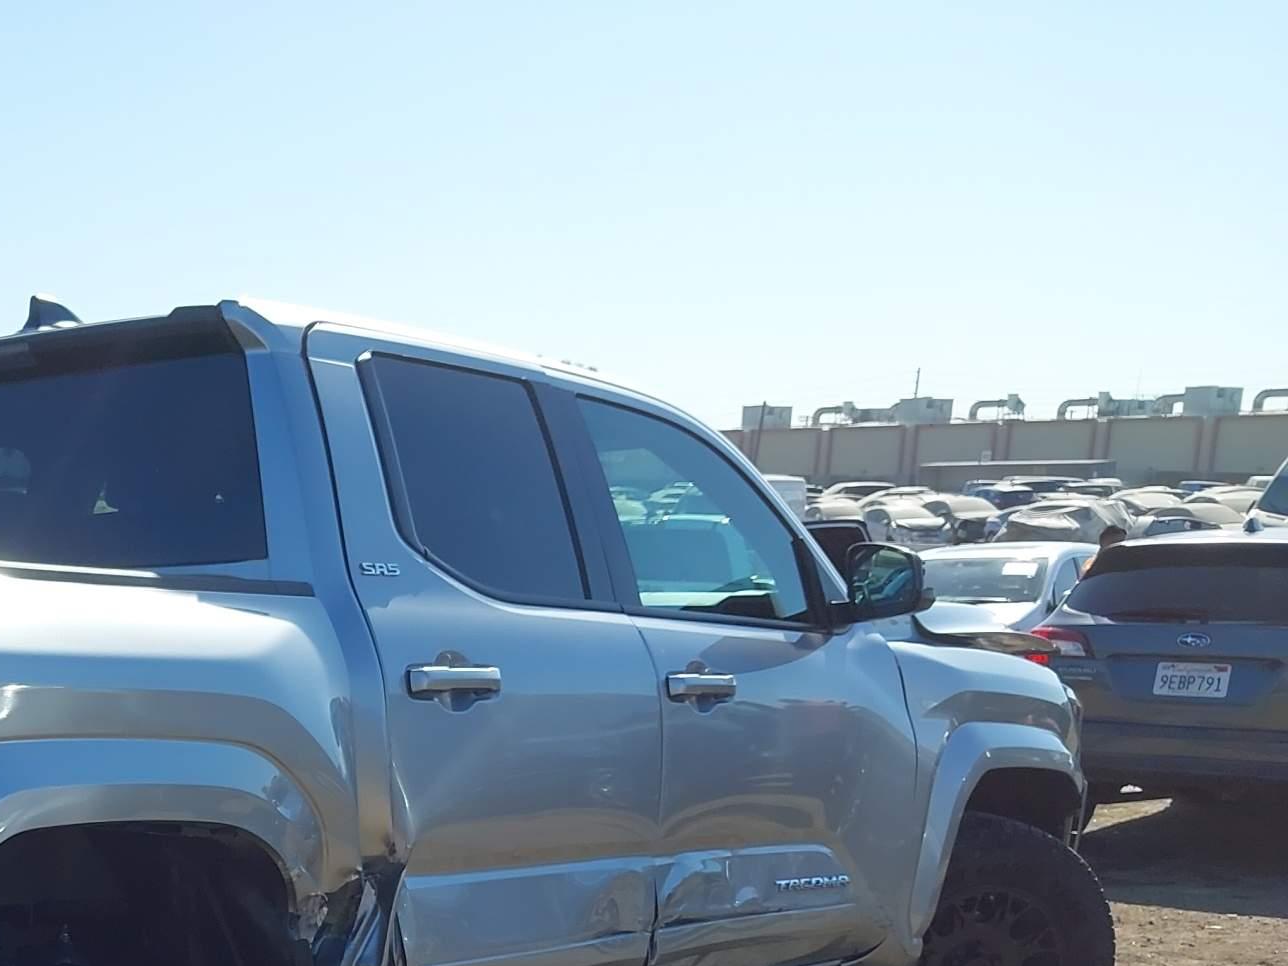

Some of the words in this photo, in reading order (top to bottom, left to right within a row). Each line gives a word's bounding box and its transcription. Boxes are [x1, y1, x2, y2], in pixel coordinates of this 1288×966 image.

[360, 562, 401, 576] SR5
[1159, 674, 1222, 692] 9EBP791
[775, 875, 849, 890] TACOMA
